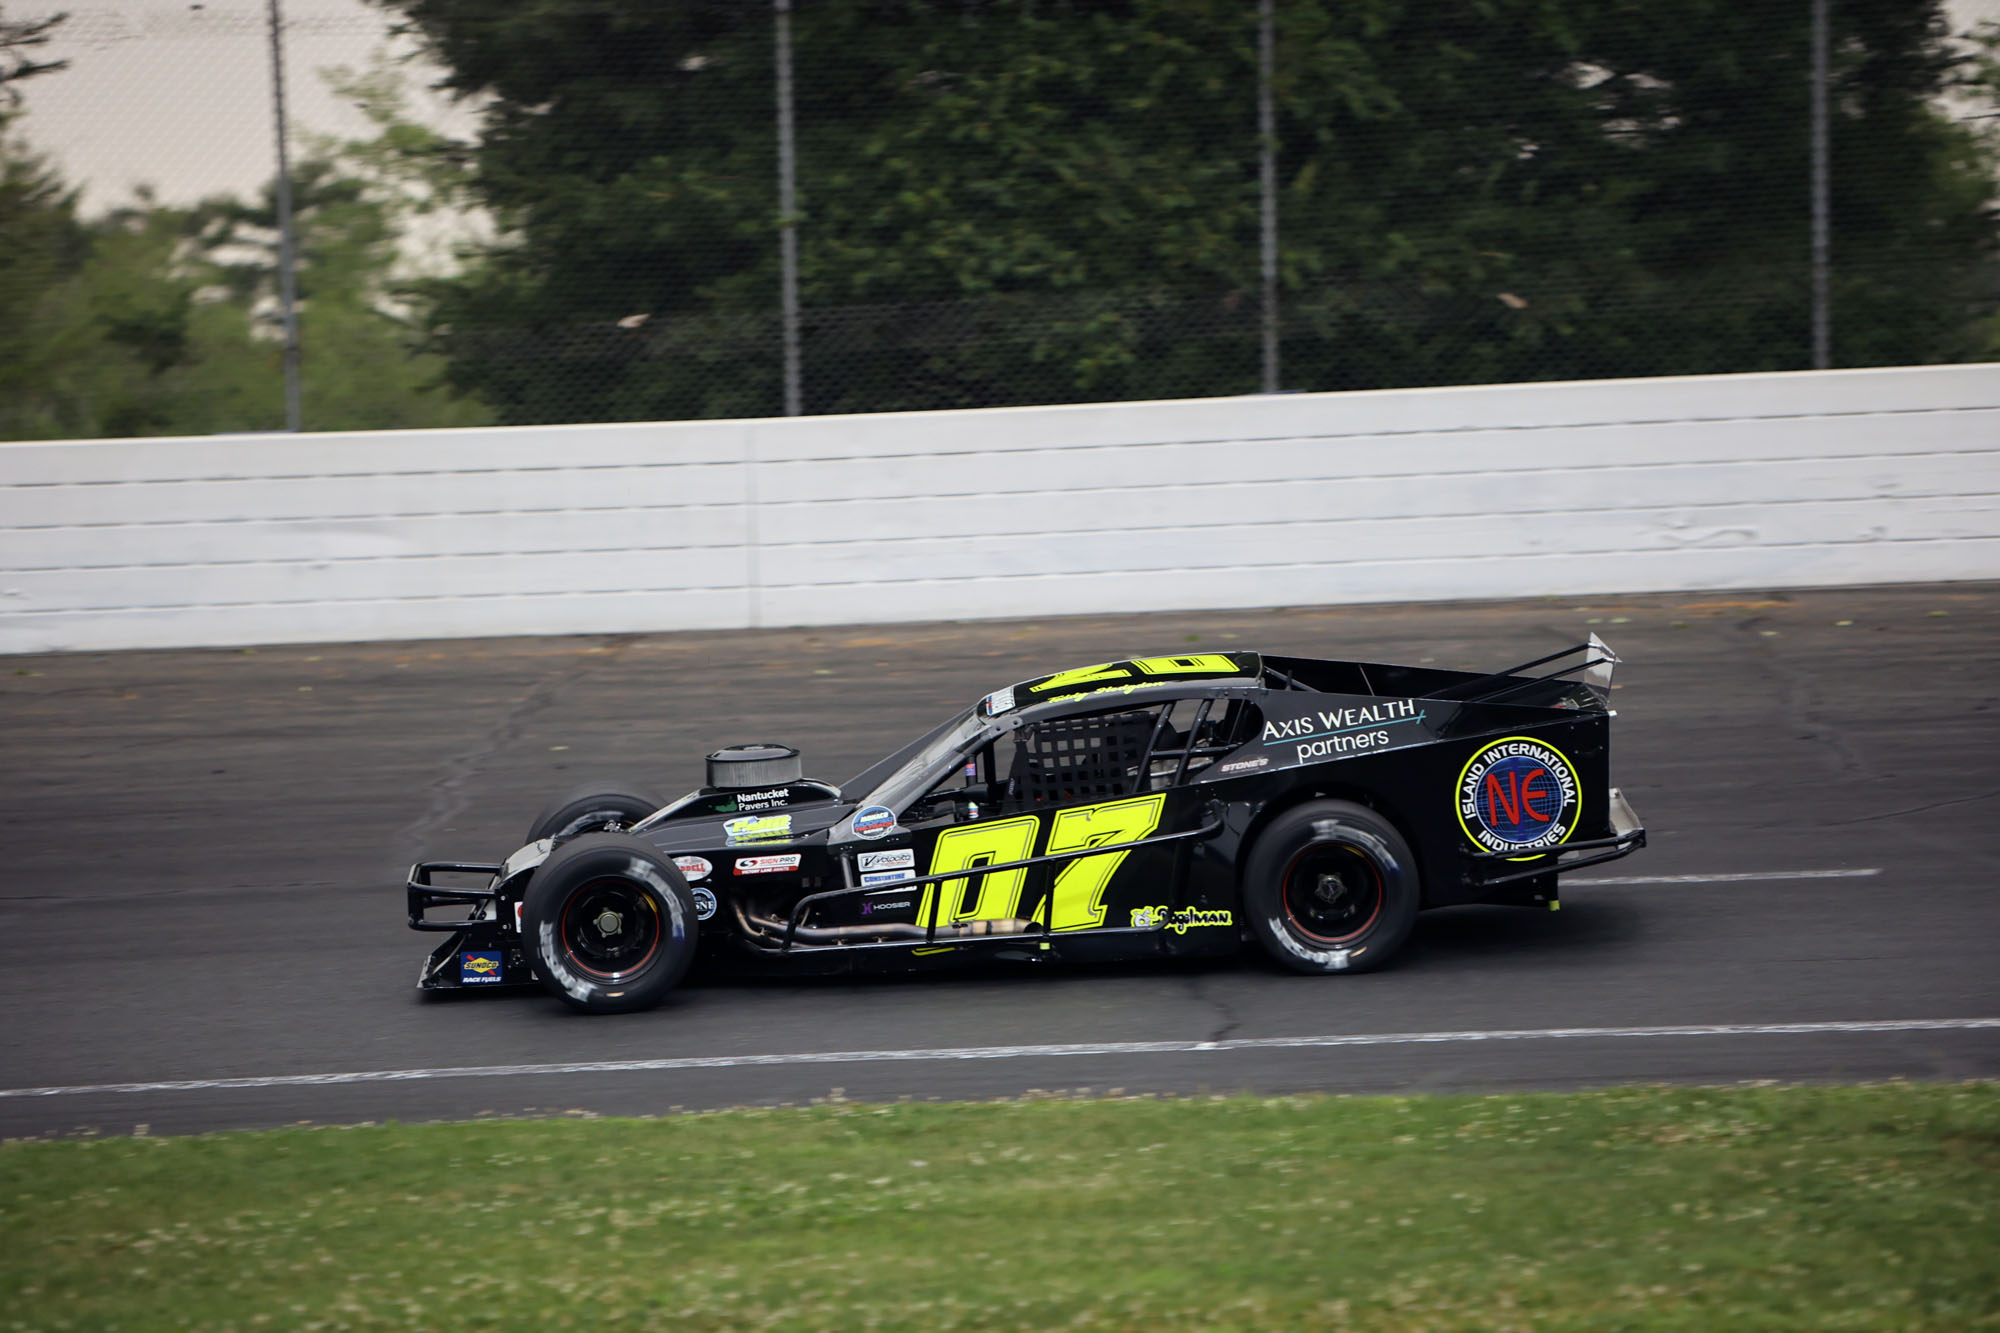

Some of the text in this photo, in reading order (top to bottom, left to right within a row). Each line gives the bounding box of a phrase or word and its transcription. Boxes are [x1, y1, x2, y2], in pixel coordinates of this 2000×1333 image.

[1262, 699, 1415, 741] AXIS WEALTH
[1296, 730, 1389, 764] partners
[736, 788, 790, 803] Nantucket
[1461, 743, 1576, 819] ISLAND INTERNATIONAL
[738, 799, 788, 811] Pavers Inc.
[915, 793, 1167, 932] 07
[873, 901, 911, 910] HOOSIER
